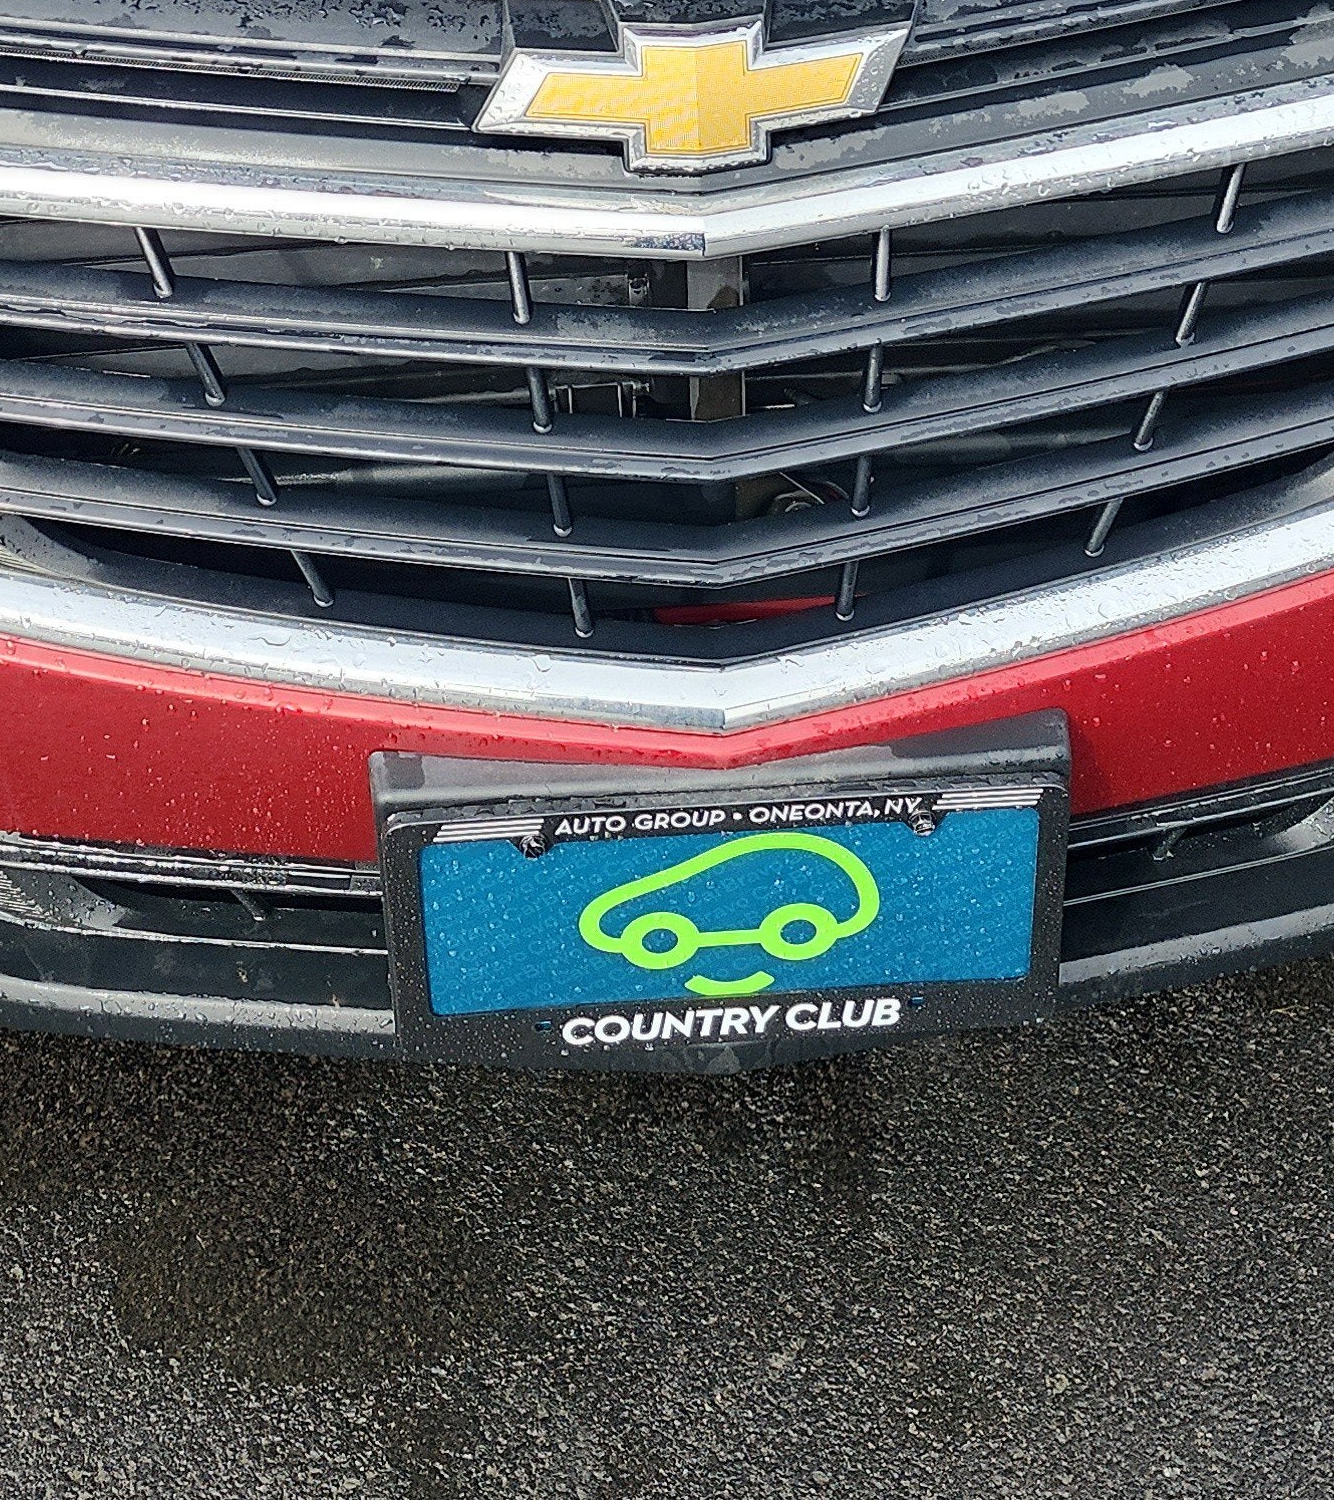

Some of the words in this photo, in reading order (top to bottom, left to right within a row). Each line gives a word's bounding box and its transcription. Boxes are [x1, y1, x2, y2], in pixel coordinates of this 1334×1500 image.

[554, 815, 627, 836] AUTO
[633, 809, 727, 830] GROUP
[749, 801, 881, 824] ONEONTA,
[884, 796, 923, 815] NY
[561, 1004, 780, 1046] COUNTRY
[785, 998, 901, 1031] CLUB
